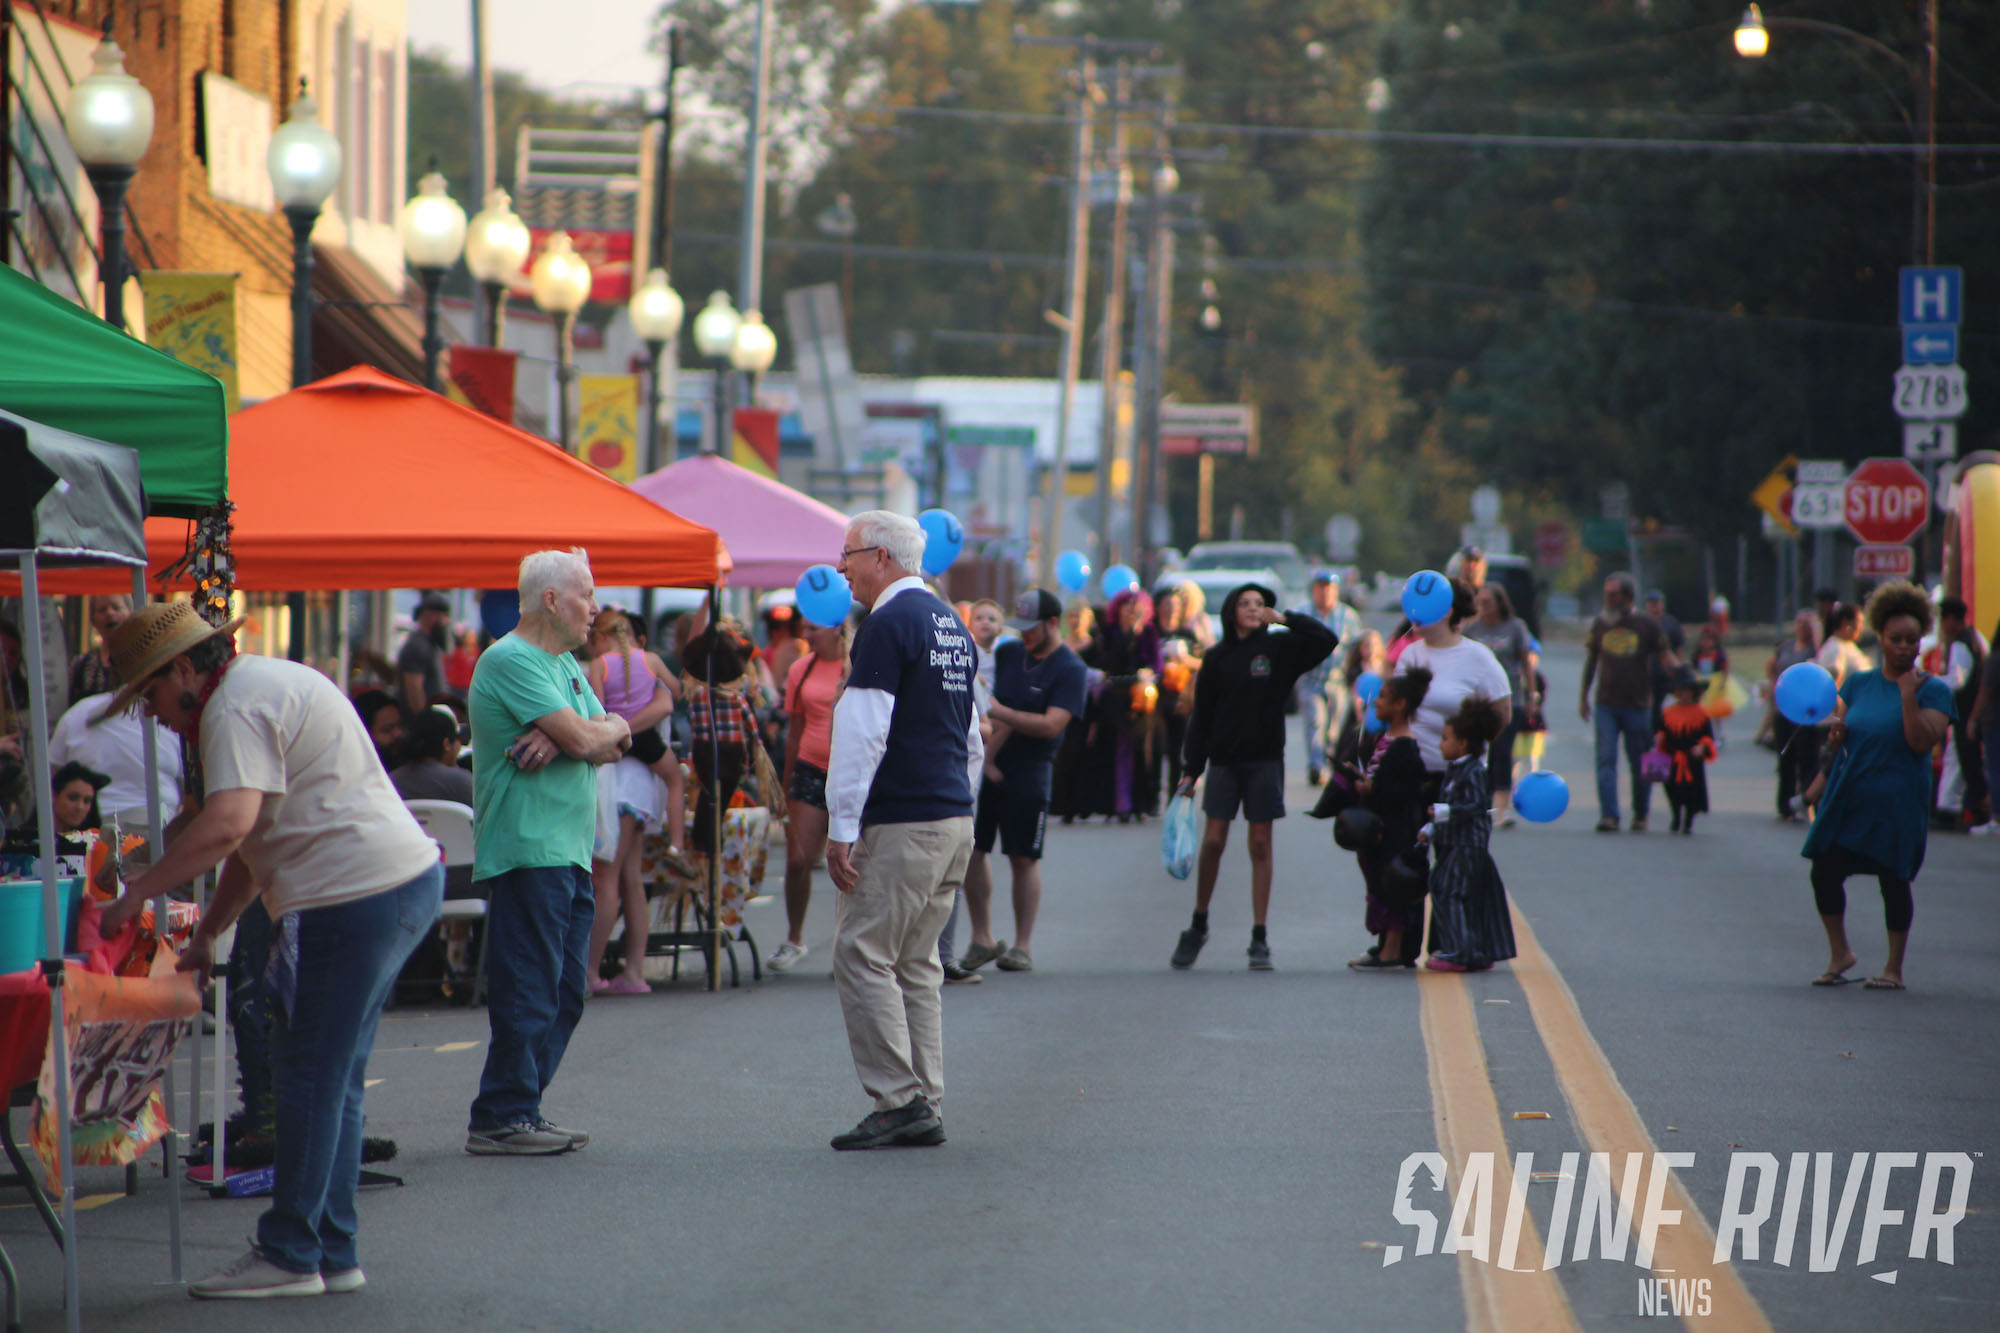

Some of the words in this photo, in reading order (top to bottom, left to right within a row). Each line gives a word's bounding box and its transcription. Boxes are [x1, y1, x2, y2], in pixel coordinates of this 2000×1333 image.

[1913, 275, 1948, 321] H
[1850, 485, 1924, 521] STOP
[1414, 574, 1438, 596] U
[933, 629, 968, 652] Missionary
